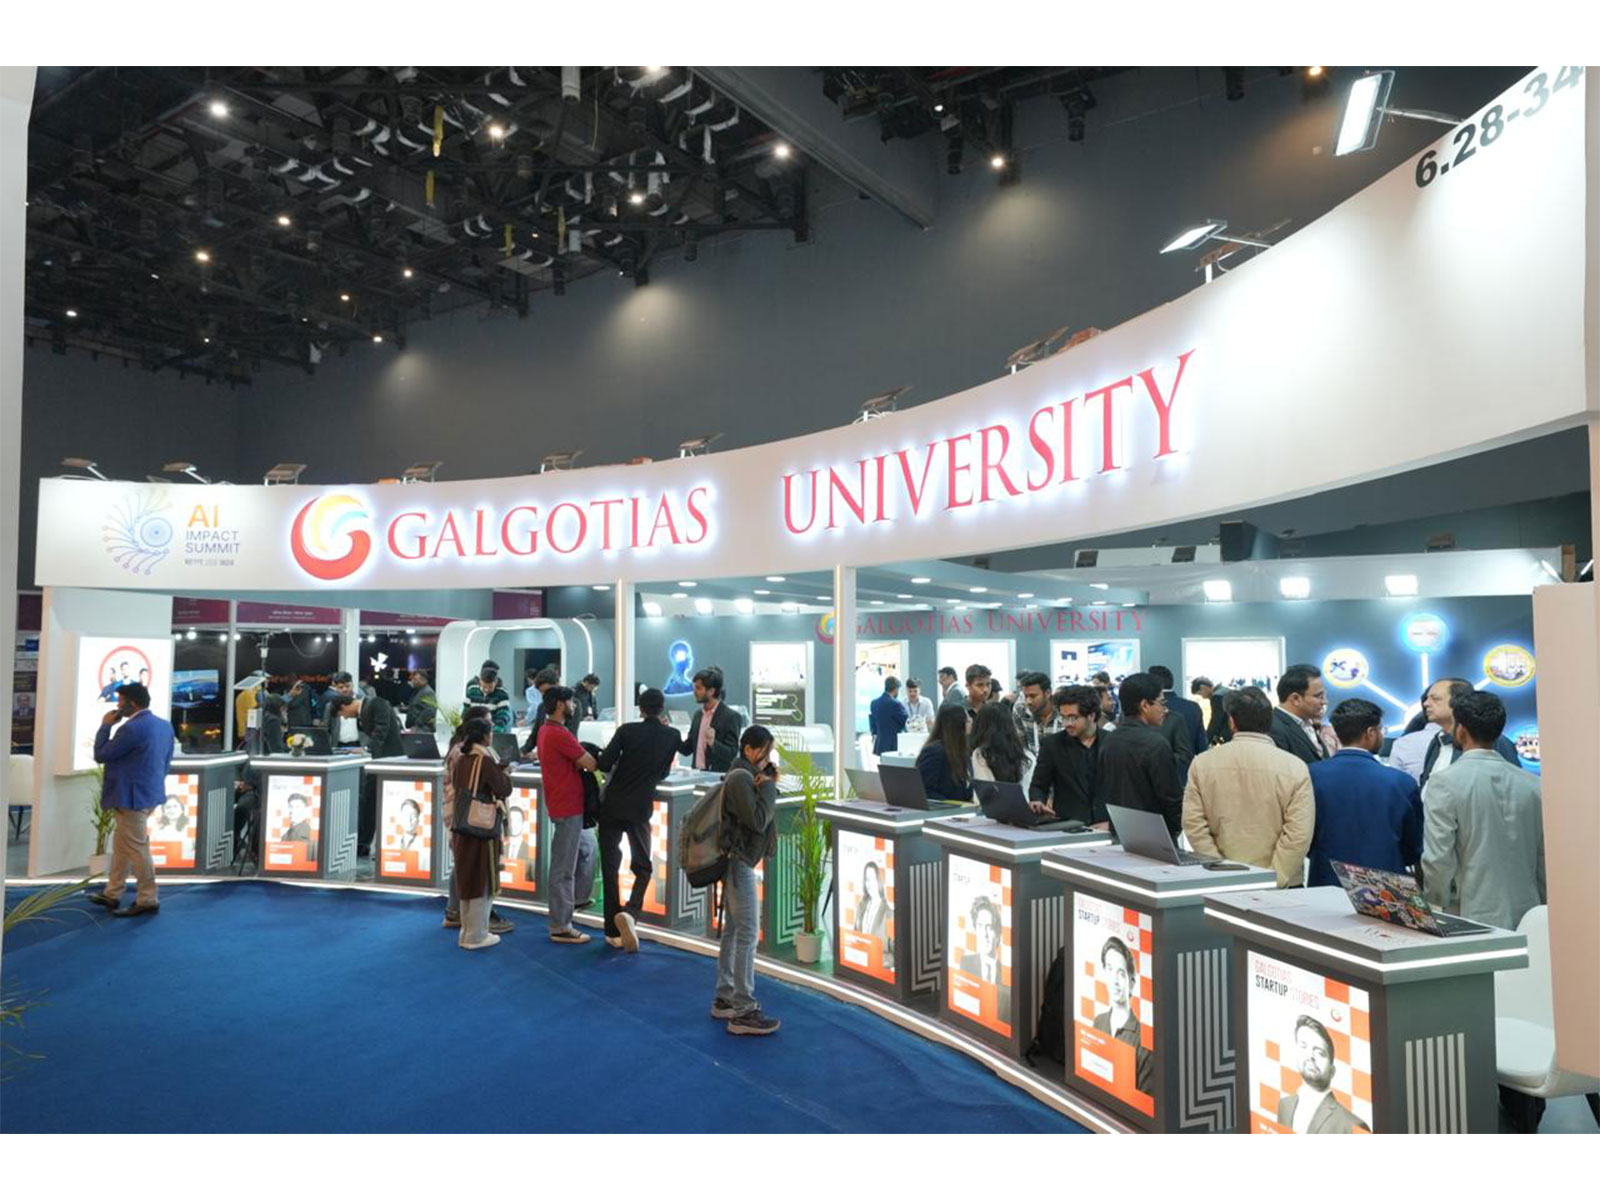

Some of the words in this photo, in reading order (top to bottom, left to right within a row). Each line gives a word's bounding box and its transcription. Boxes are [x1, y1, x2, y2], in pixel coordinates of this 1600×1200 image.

[387, 487, 709, 560] GALGOTIAS
[782, 349, 1196, 535] UNIVERSITY
[187, 504, 219, 528] AI
[186, 530, 239, 541] IMPACT
[185, 542, 240, 553] SUMMIT
[987, 609, 1143, 632] UNIVERSITY
[1255, 975, 1288, 997] STARTUP
